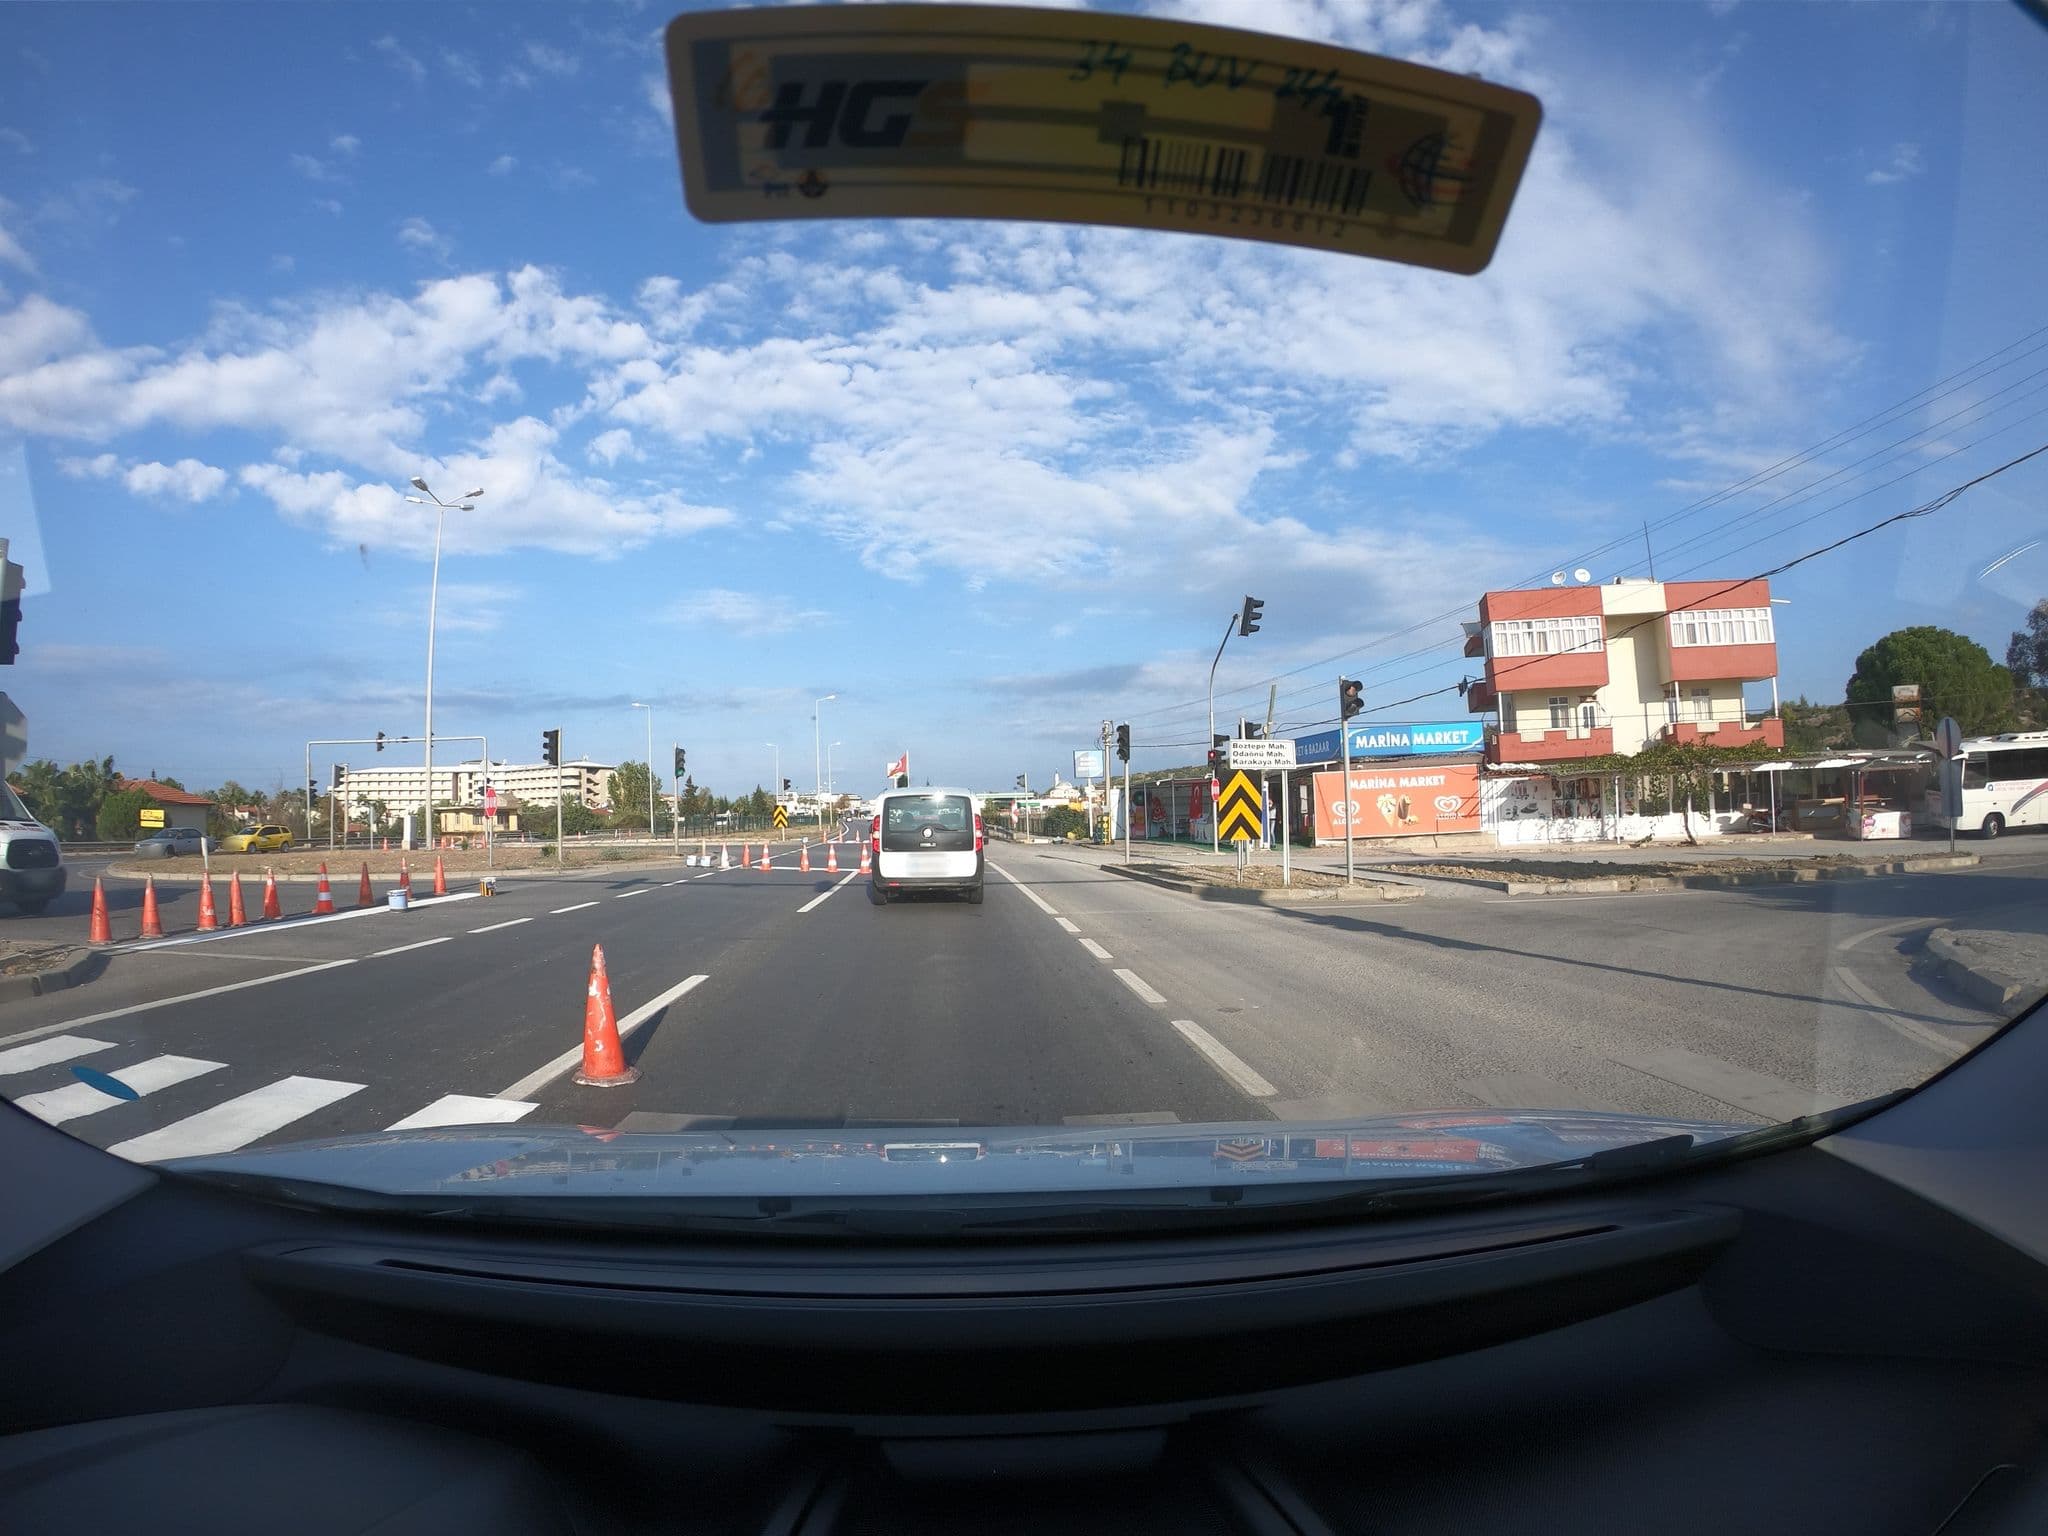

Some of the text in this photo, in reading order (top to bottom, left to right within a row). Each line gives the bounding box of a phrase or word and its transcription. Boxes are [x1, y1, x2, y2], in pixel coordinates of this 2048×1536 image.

[758, 80, 973, 149] HGS
[1355, 730, 1469, 748] MARİNA MARKET
[1349, 775, 1446, 790] MARİNA MARKET
